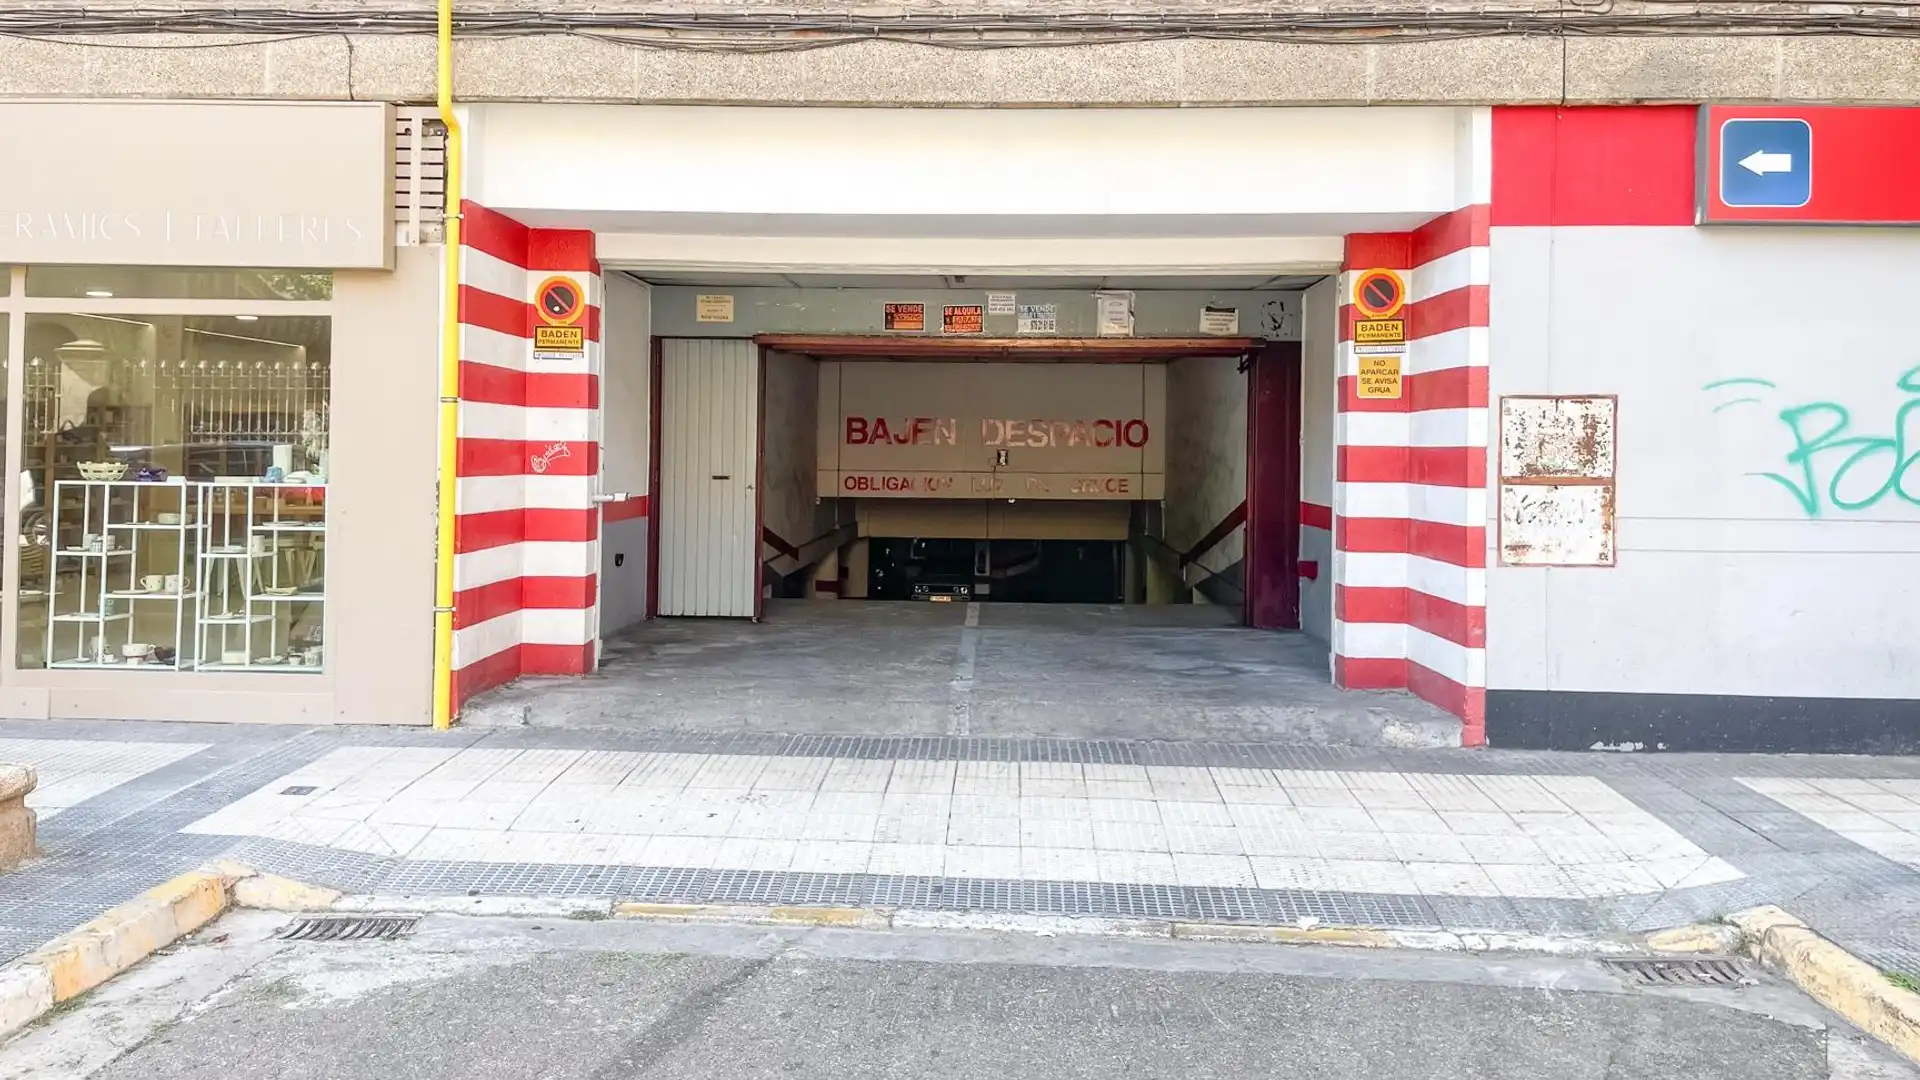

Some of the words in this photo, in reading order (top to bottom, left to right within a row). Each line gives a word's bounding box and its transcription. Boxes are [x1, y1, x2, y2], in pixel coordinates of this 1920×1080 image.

[885, 304, 896, 314] SE
[897, 304, 924, 314] VENDE
[944, 307, 953, 316] SE
[953, 306, 982, 316] ALQUILA
[1360, 323, 1399, 332] BADEN
[541, 330, 577, 338] BADEN
[1360, 368, 1399, 376] APARCAR
[1361, 377, 1372, 385] SE
[1374, 377, 1398, 385] AVISA
[1367, 386, 1391, 394] GRUA
[845, 417, 956, 445] BAJEN
[981, 418, 1149, 448] DESPACIO
[844, 475, 953, 492] OBLIGAION
